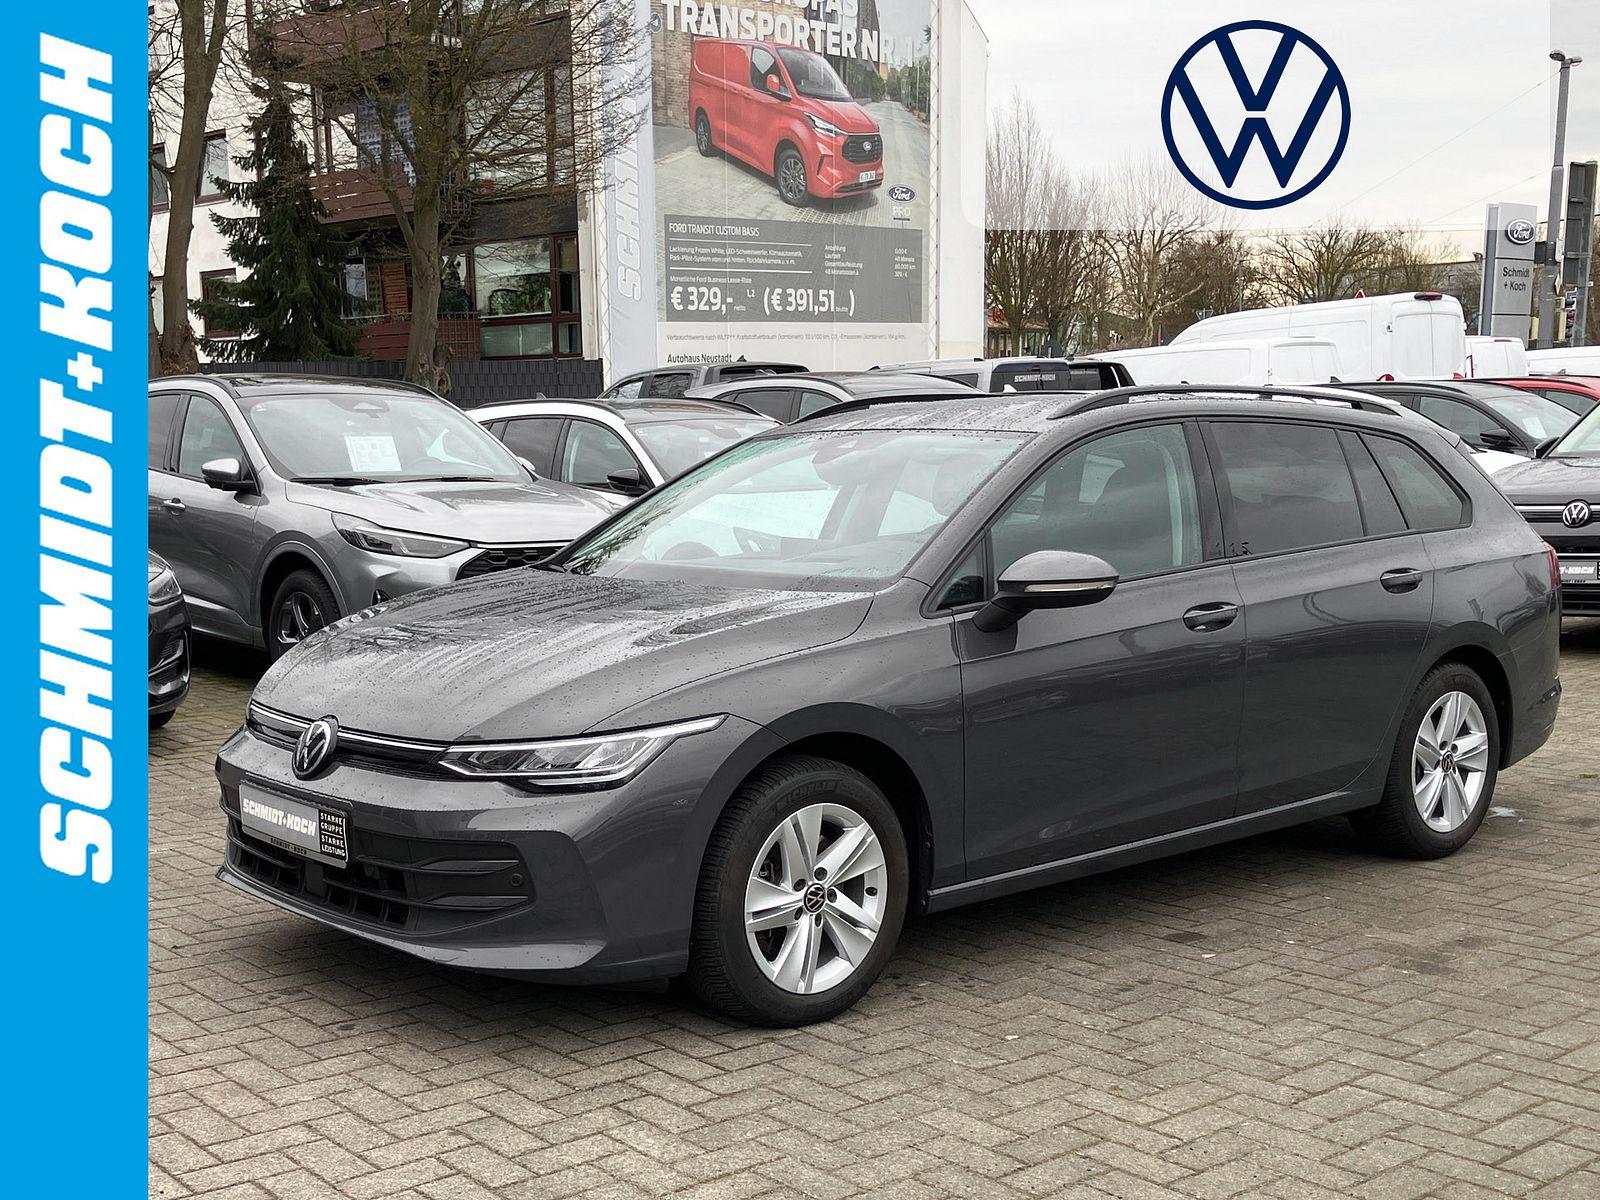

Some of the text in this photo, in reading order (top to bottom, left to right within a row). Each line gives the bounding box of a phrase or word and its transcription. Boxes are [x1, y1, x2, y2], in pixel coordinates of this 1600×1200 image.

[662, 1, 857, 59] TRANSPORTER
[890, 186, 914, 202] Ford
[892, 206, 911, 217] PRO
[669, 223, 760, 237] FORD TRANSIT CUSTOM BASIS
[1511, 221, 1533, 241] Ford
[696, 275, 707, 283] Ford
[1502, 267, 1530, 278] Schmidt
[1509, 281, 1526, 291] Koch
[670, 286, 684, 311] €
[687, 286, 733, 315] 329,-
[786, 288, 835, 315] 391,51
[667, 354, 732, 363] Autohaus Neustadt
[243, 798, 317, 837] SCHMIDT+KOCH
[320, 812, 343, 825] STARKE
[320, 822, 343, 835] GRUPPE
[321, 836, 344, 848] STARKE
[321, 844, 345, 857] LEISTUNG
